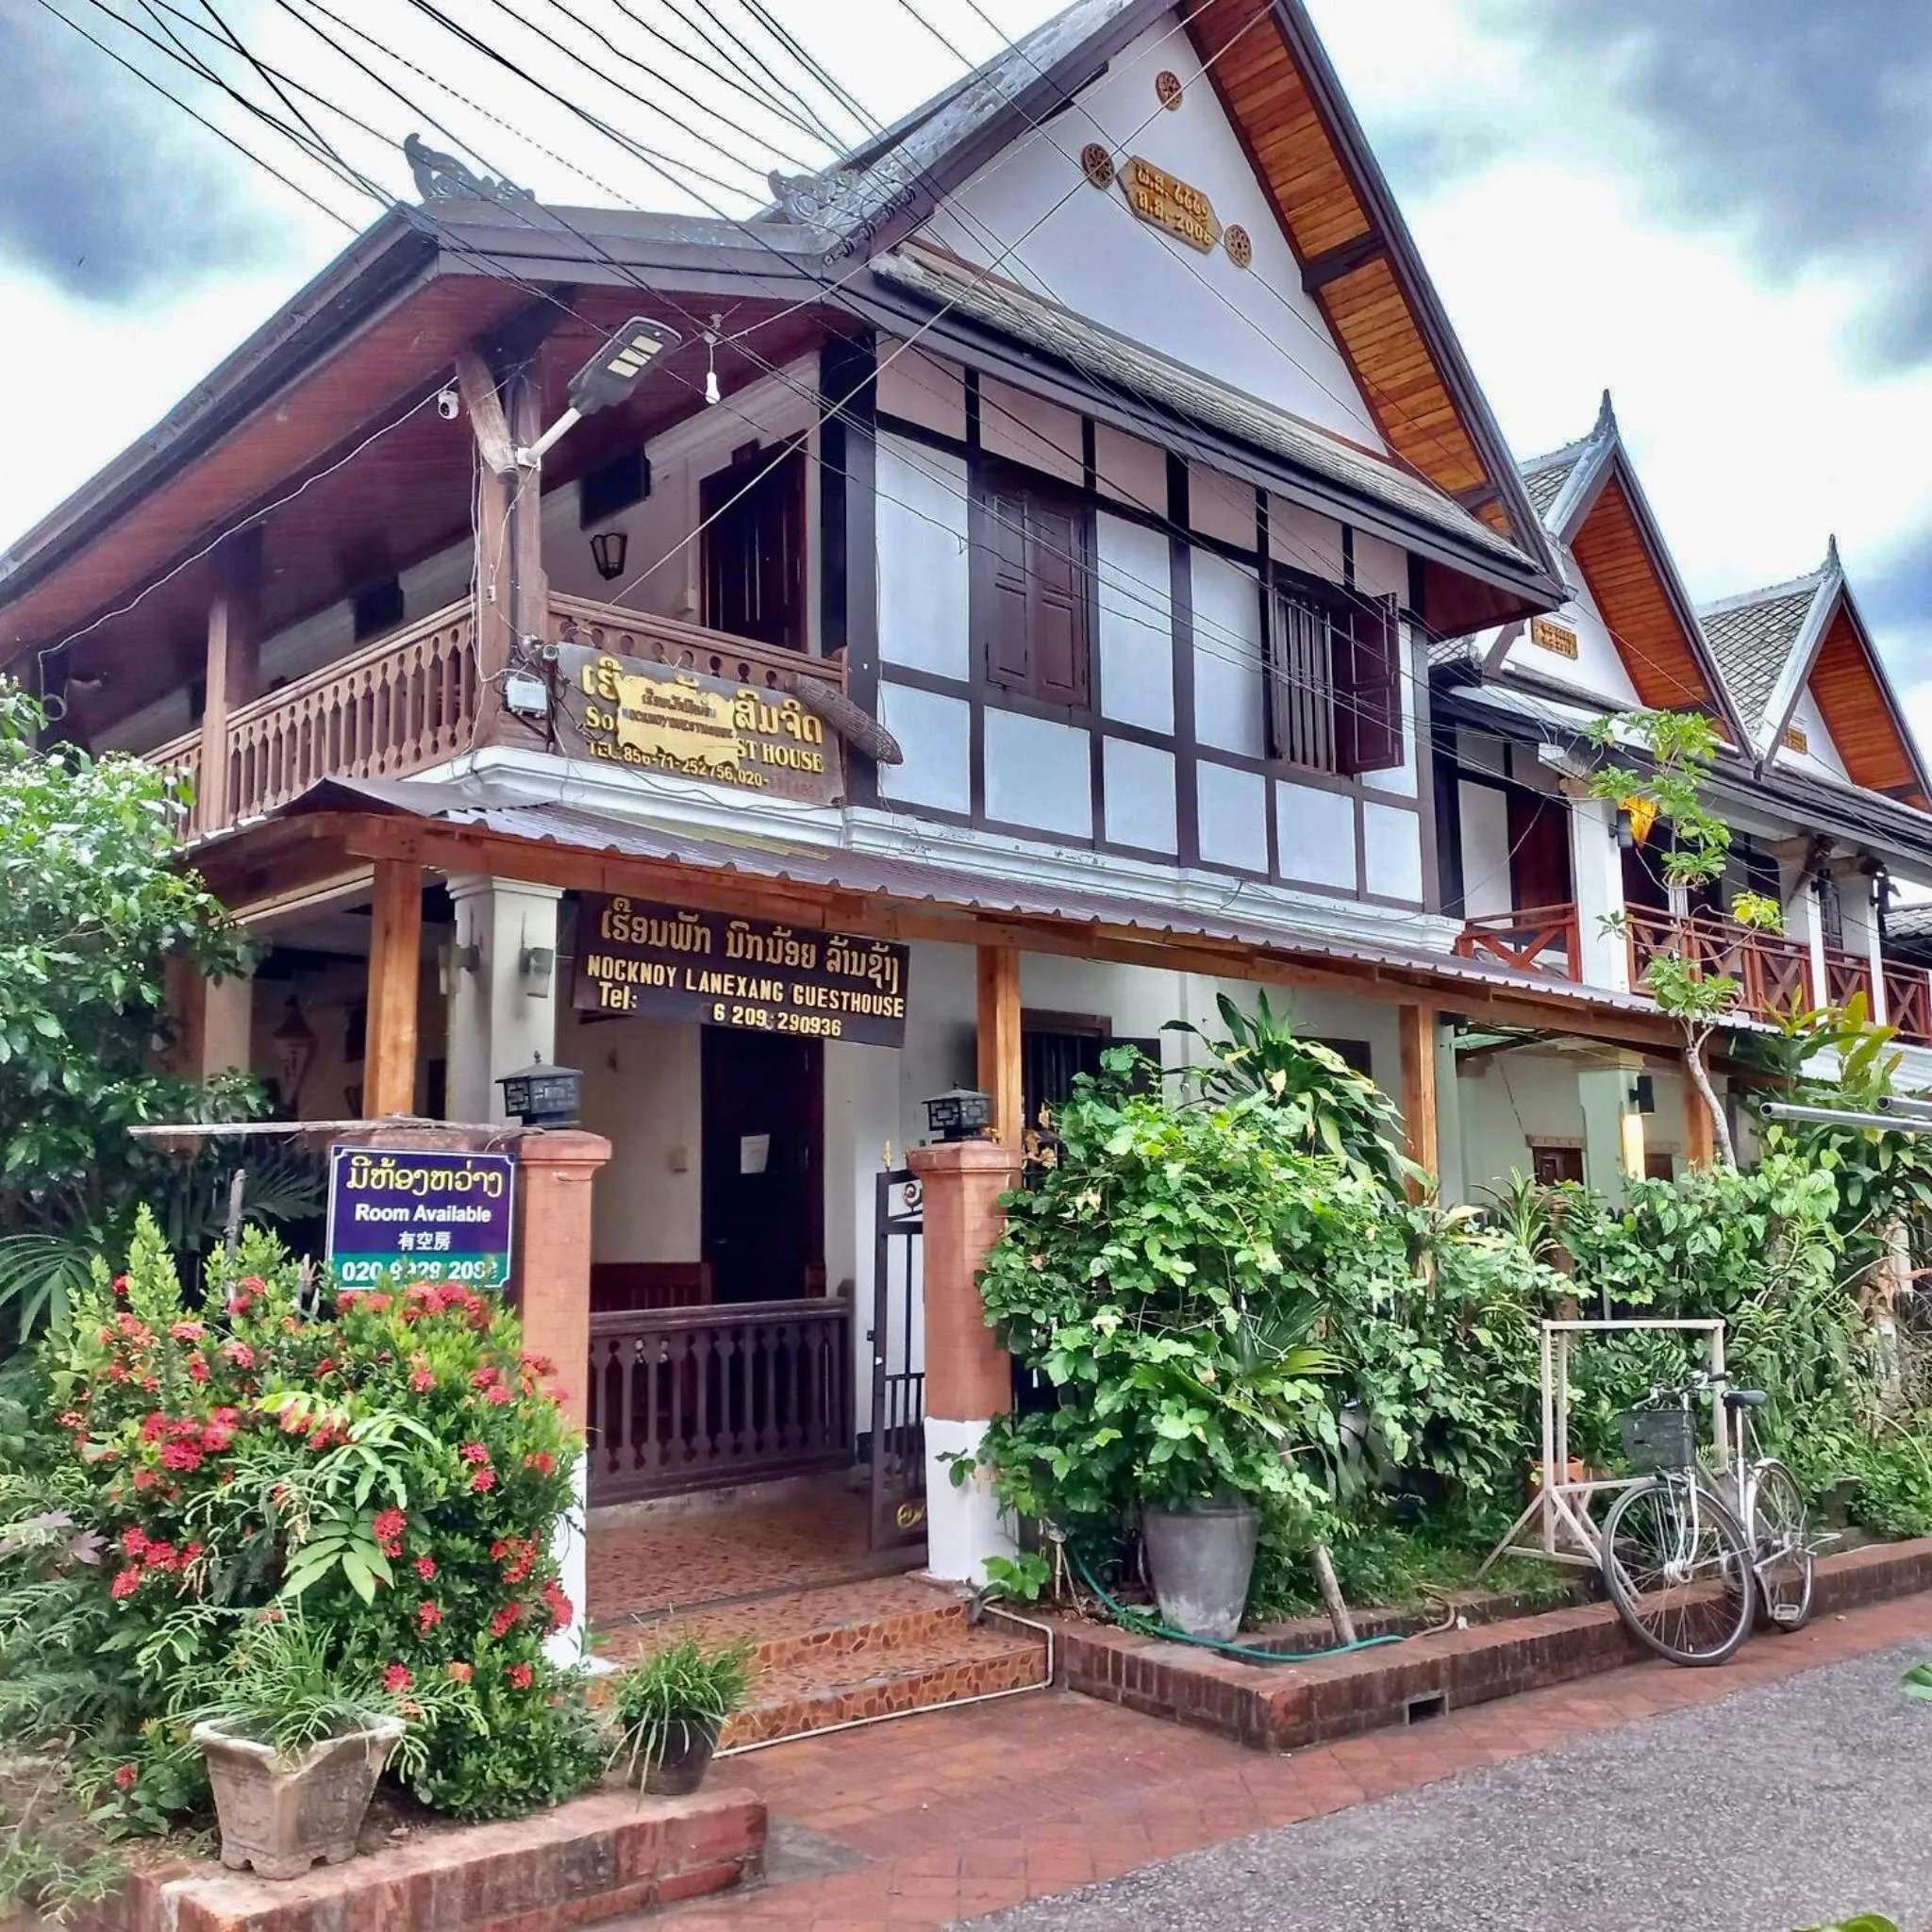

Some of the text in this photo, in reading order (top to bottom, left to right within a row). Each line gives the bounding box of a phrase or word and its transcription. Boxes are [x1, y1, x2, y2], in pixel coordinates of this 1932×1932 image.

[761, 742, 824, 774] HOUSE
[587, 954, 905, 1019] NOCKNOY LANEXANG GUESTHOUSE
[776, 1012, 842, 1037] 290936
[355, 1203, 491, 1224] Room Available
[397, 1230, 452, 1251] 有空房
[341, 1260, 383, 1281] 020
